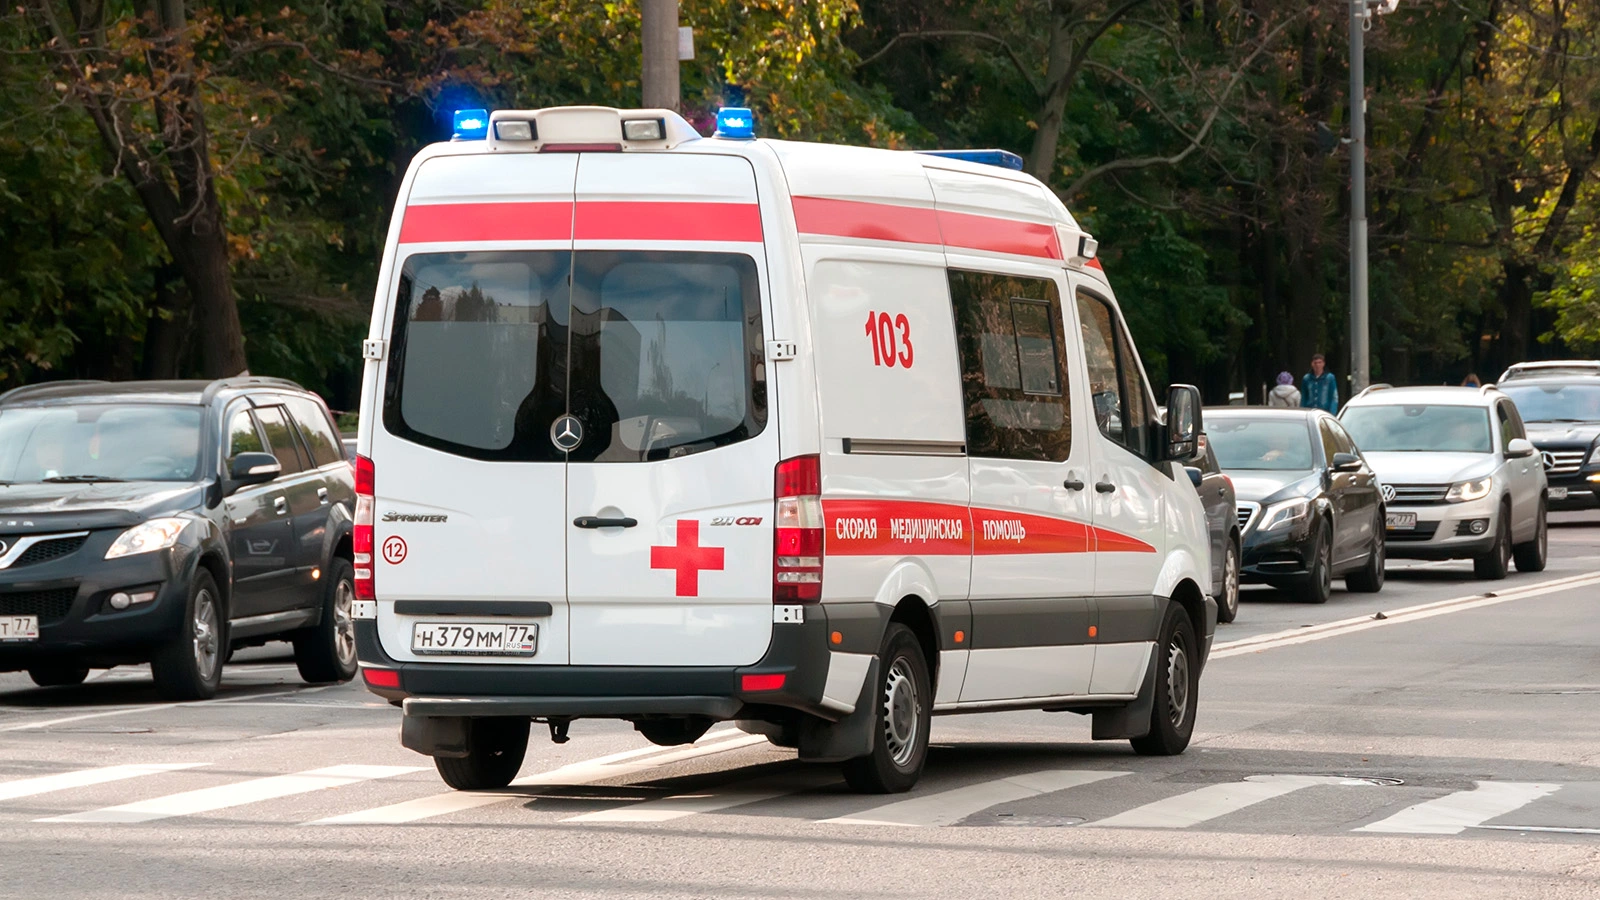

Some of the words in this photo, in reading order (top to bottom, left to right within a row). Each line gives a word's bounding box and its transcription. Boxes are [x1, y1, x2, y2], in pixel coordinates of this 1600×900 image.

[865, 310, 914, 369] 103
[710, 516, 735, 526] 211
[735, 516, 763, 526] CDI
[1398, 514, 1413, 523] 777
[835, 518, 877, 540] СКОРАЯ
[890, 518, 963, 544] МЕДИЦИНСКАЯ
[982, 519, 1026, 544] ПОМОЩЬ
[386, 542, 403, 558] 12
[14, 618, 31, 631] 77
[508, 626, 529, 643] 77
